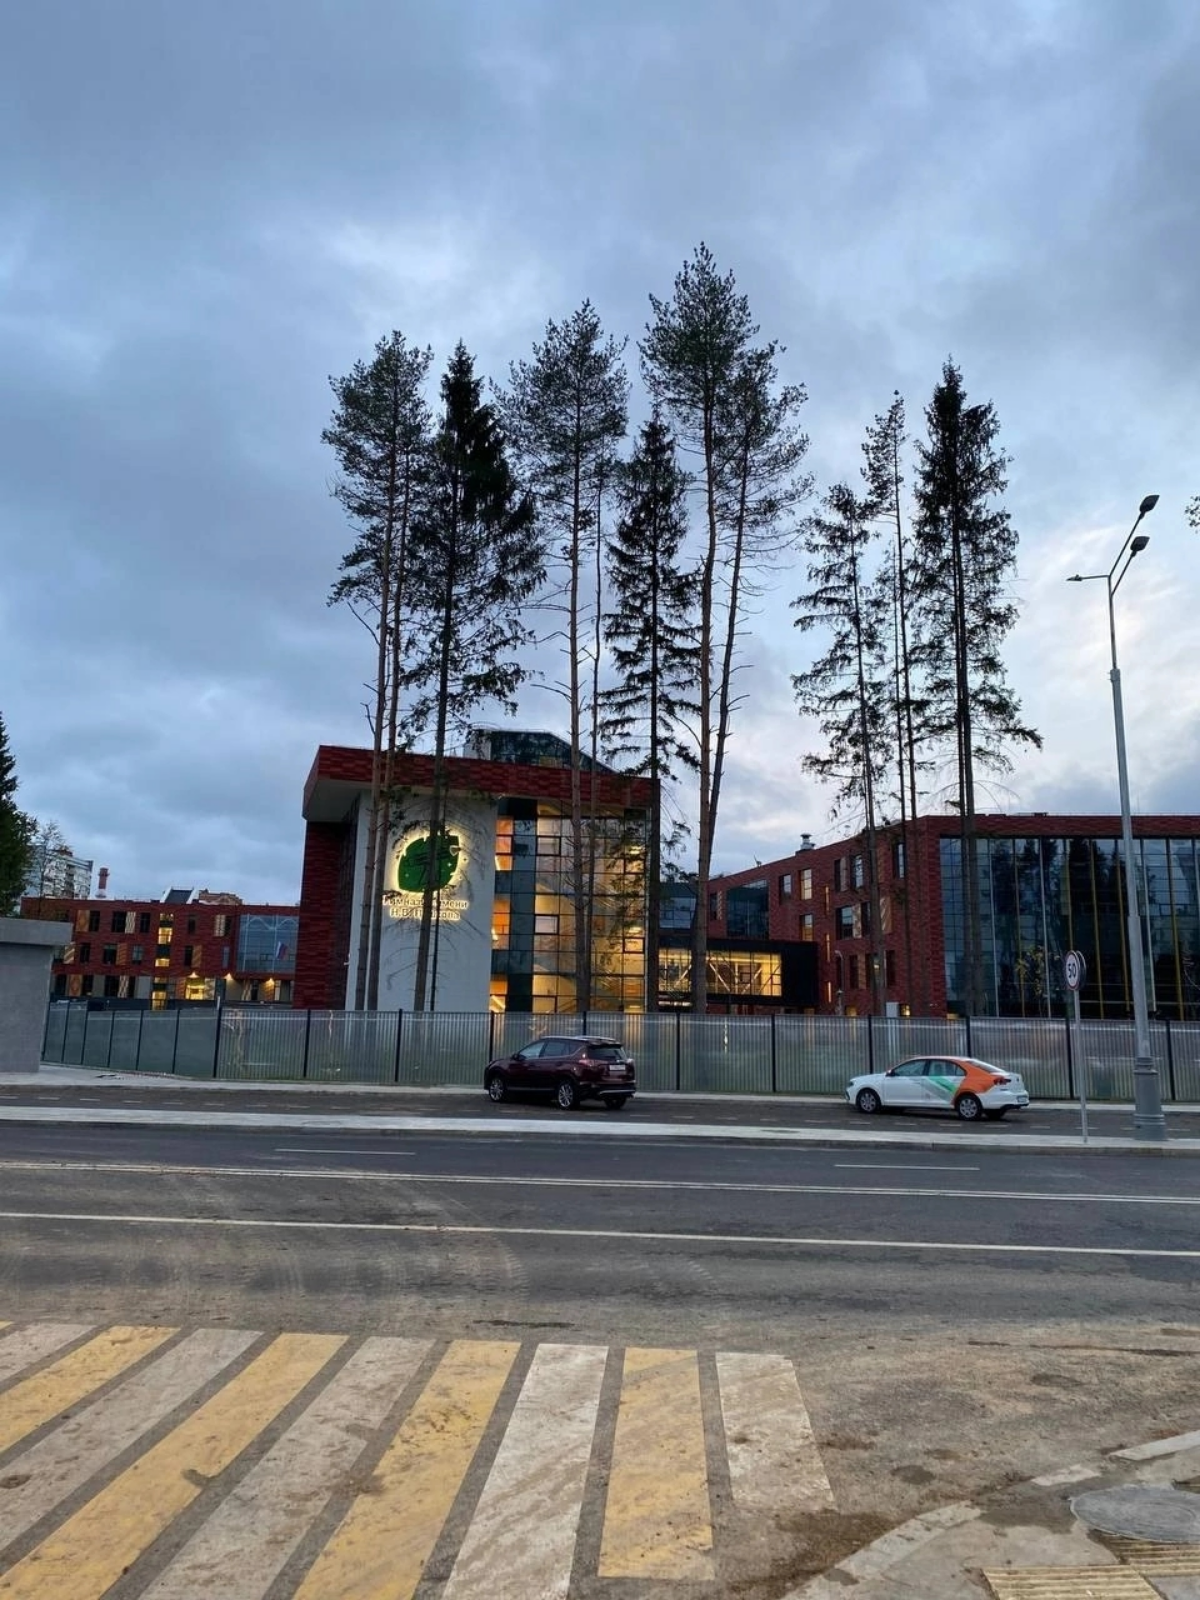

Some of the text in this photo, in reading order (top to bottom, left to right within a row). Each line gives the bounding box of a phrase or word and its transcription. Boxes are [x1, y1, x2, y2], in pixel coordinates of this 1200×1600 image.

[382, 894, 469, 909] Гимнази мени
[1068, 963, 1077, 978] 50
